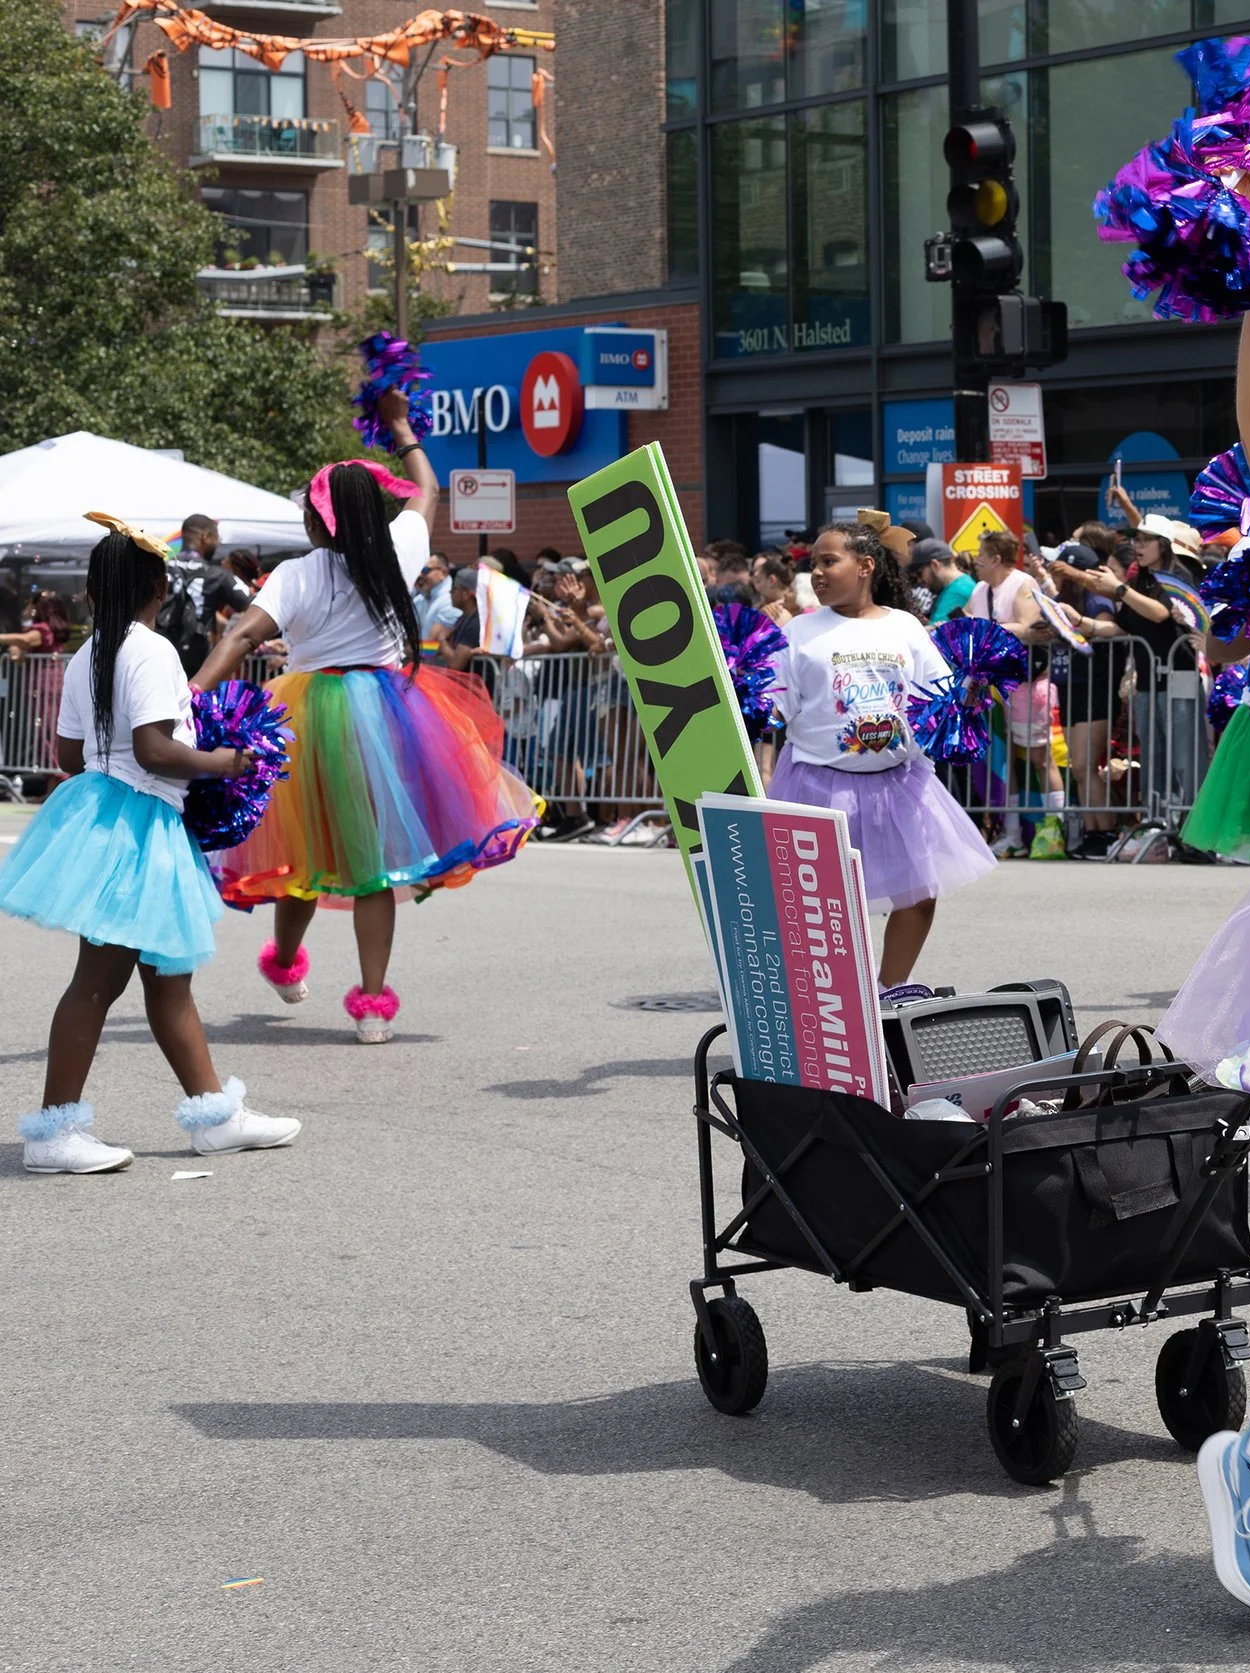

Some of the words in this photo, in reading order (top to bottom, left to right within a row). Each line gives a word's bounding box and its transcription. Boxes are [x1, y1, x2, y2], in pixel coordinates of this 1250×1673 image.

[738, 327, 769, 352] 3601
[772, 324, 788, 349] N
[793, 318, 851, 347] Halsted
[600, 353, 630, 365] BMO
[615, 391, 639, 404] ATM
[430, 384, 510, 436] BMO
[897, 425, 933, 445] Deposit
[897, 449, 929, 468] Change
[954, 469, 1010, 484] STREET
[945, 484, 1020, 499] CROSSING
[581, 480, 721, 760] YOU
[831, 652, 876, 666] SOUTHLAND
[832, 672, 852, 694] GO
[861, 732, 877, 741] LESS
[773, 827, 806, 958] Democrat
[793, 968, 811, 1004] for
[827, 898, 847, 957] Elect
[762, 930, 777, 947] IL
[766, 954, 785, 994] 2nd
[772, 1000, 794, 1078] District
